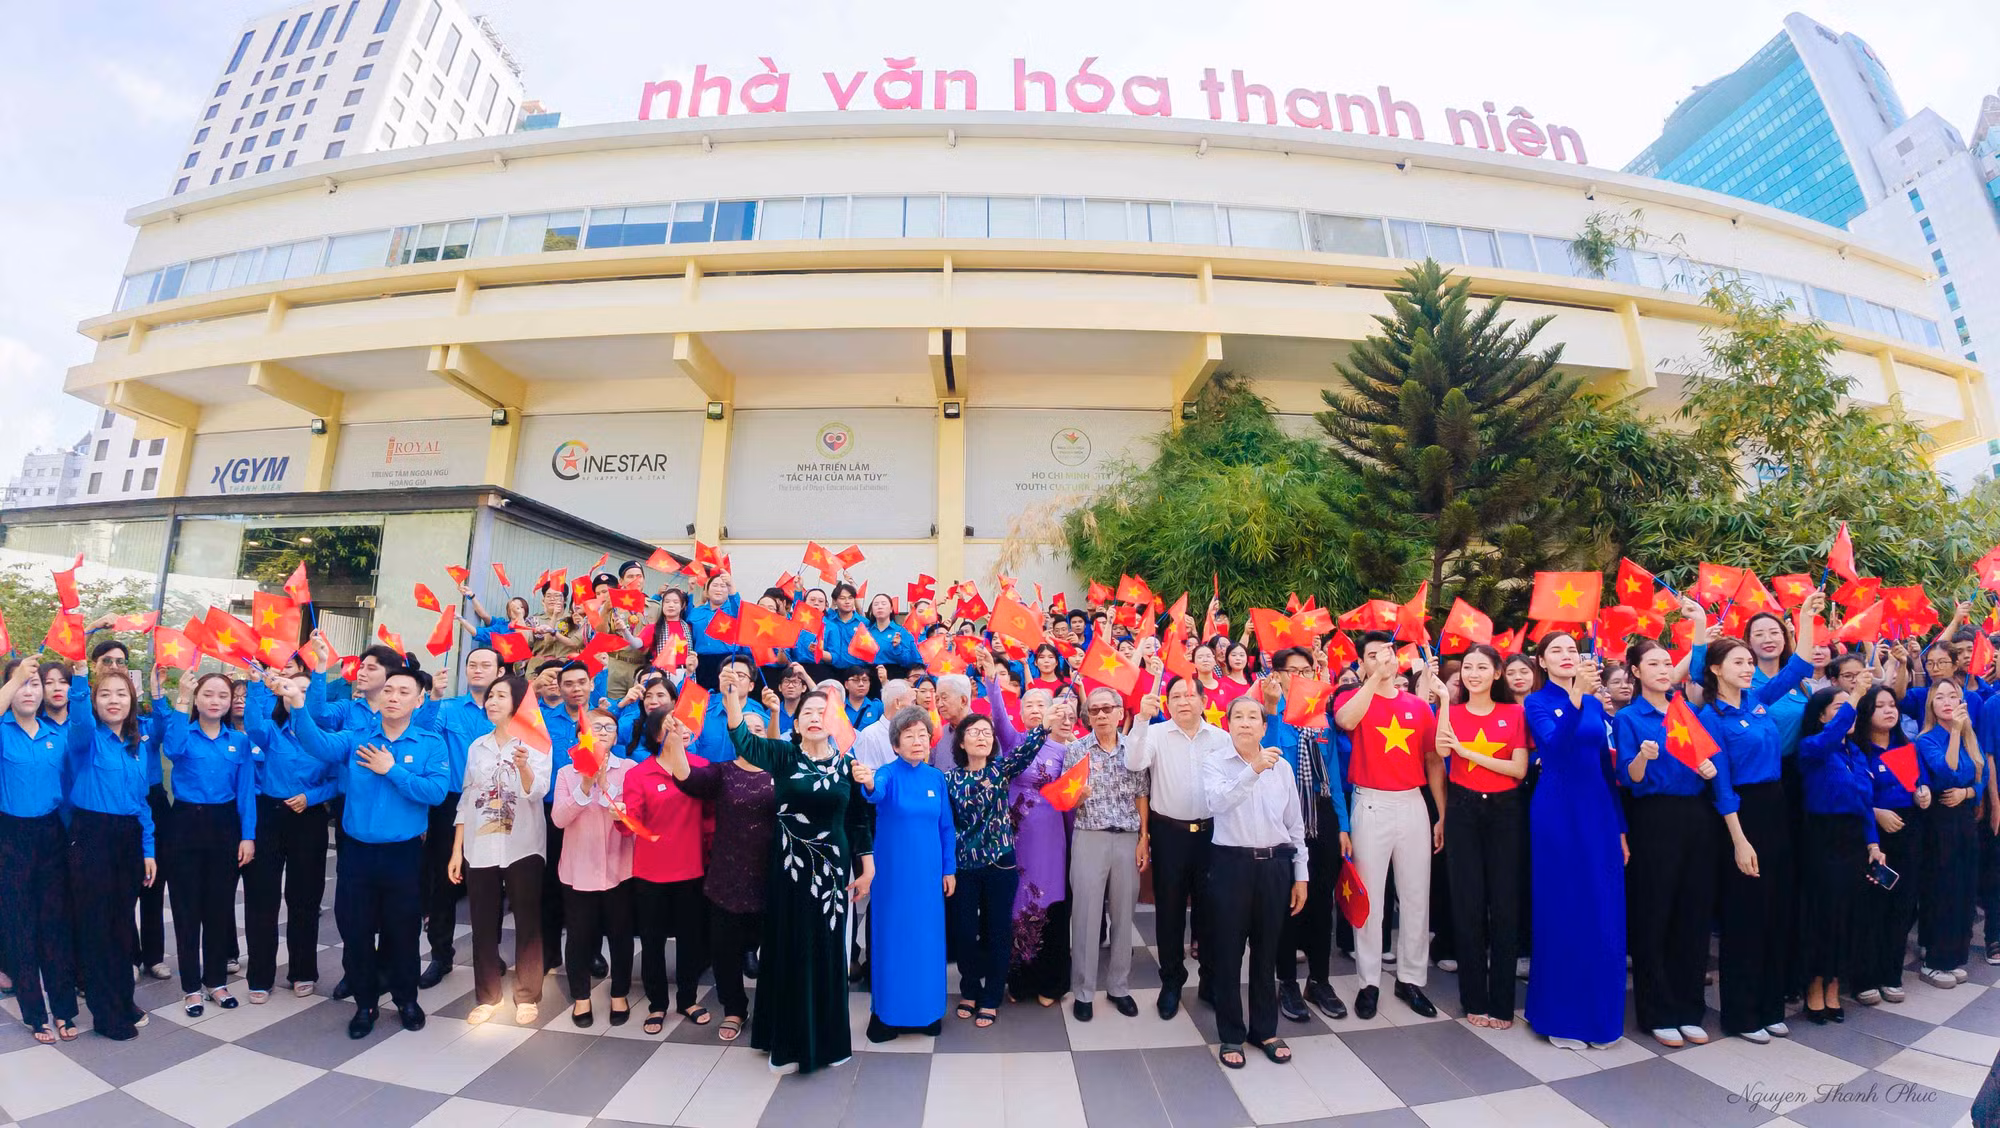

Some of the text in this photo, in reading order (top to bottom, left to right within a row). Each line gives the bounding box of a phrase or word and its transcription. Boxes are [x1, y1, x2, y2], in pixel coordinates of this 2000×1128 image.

[638, 56, 1589, 165] nhà văn hóa thanh niên
[393, 440, 441, 453] ROYAL
[797, 462, 818, 471] NHÀ
[371, 470, 394, 478] TRUNG
[825, 471, 844, 481] CỦA
[846, 473, 861, 481] MA
[1031, 471, 1046, 480] HO
[1048, 471, 1063, 480] CHI
[1065, 471, 1090, 480] MINH
[1015, 482, 1047, 491] YOUTH
